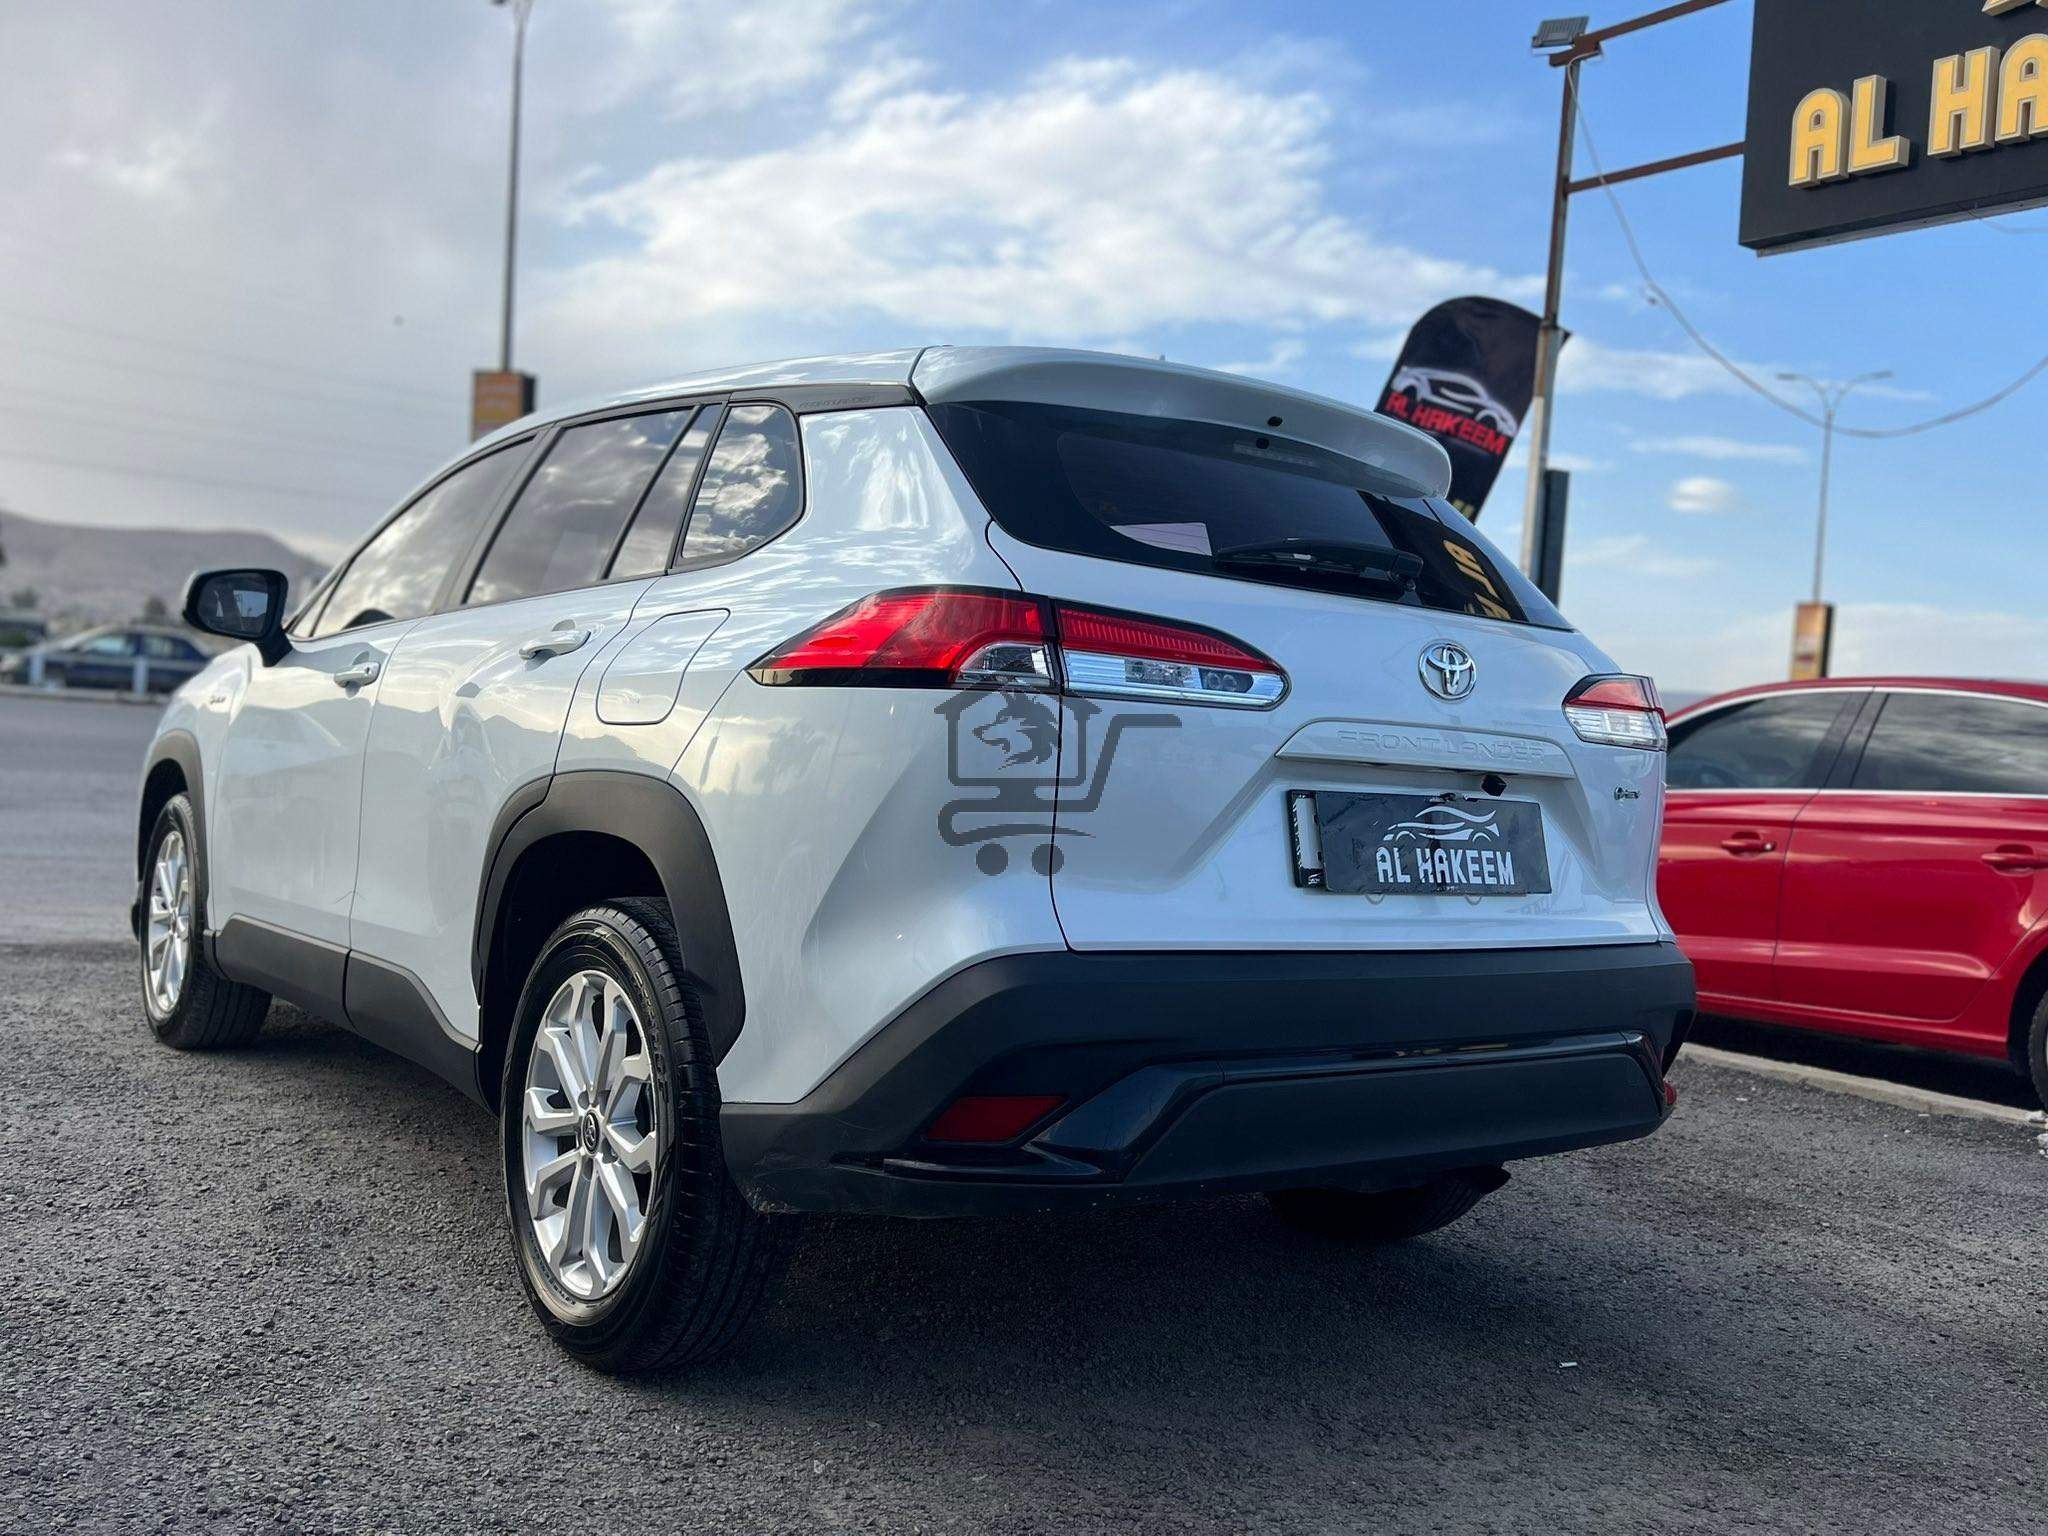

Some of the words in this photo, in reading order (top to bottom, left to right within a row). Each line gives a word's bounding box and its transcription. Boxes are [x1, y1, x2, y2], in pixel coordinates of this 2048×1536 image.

[1789, 73, 1909, 189] AL
[1384, 391, 1409, 418] AL
[1410, 404, 1508, 455] HAKEEM
[1375, 846, 1411, 883] AL
[1416, 847, 1515, 885] HAKEEM
